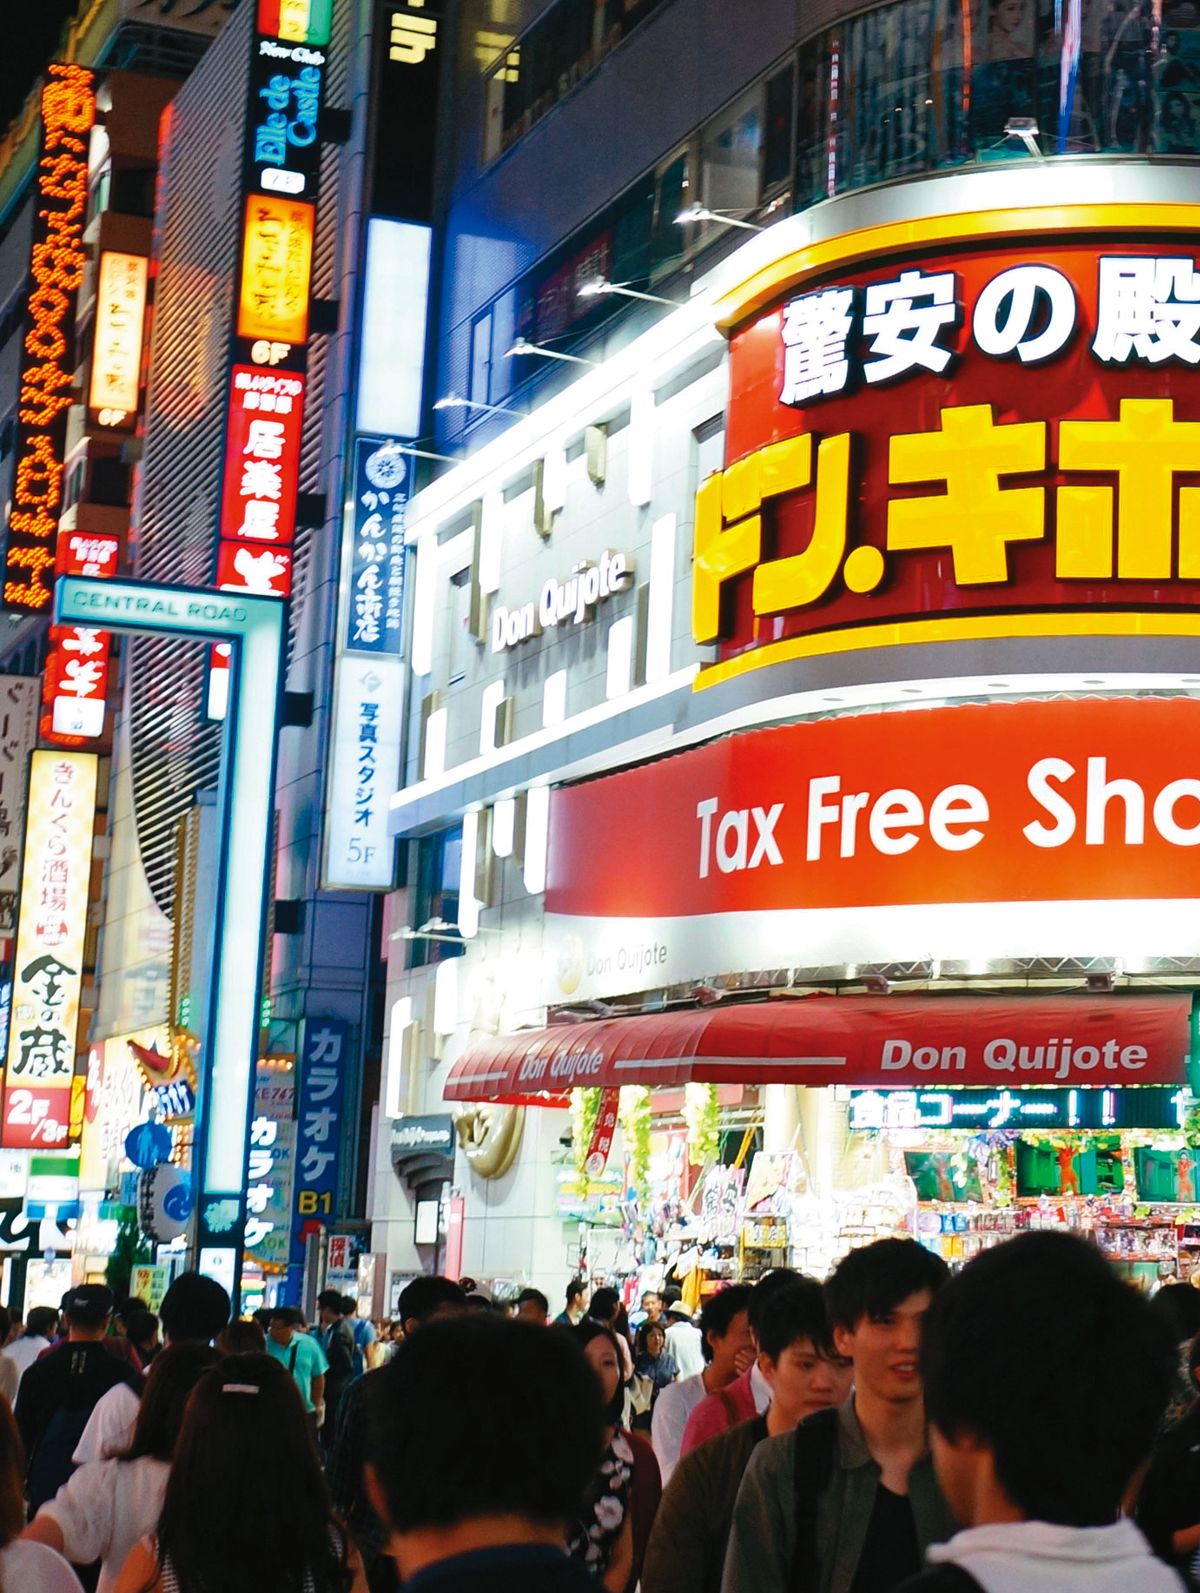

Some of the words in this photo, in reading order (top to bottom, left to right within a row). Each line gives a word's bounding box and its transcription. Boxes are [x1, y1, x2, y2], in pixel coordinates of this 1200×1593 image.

[259, 74, 291, 110] de
[286, 66, 321, 147] Castle
[251, 340, 291, 366] 6F
[238, 420, 286, 540] 居楽屋
[73, 590, 179, 617] CENTRAL
[188, 603, 248, 622] ROAD
[492, 602, 538, 653] Don
[539, 549, 632, 627] Quijote
[355, 703, 380, 827] 写真スタジオ
[41, 761, 75, 912] きんくら酒場
[347, 838, 377, 863] 5F
[697, 796, 785, 878] Tax
[806, 776, 990, 861] Free
[617, 943, 668, 973] Quijote
[13, 954, 78, 1077] 金の蔵
[519, 1055, 548, 1081] Don
[550, 1052, 604, 1083] Quijote
[881, 1038, 967, 1070] Don
[982, 1038, 1149, 1078] Quijote
[302, 1028, 342, 1182] カラオケ
[244, 1116, 277, 1247] カラオケ
[298, 1191, 331, 1214] B1
